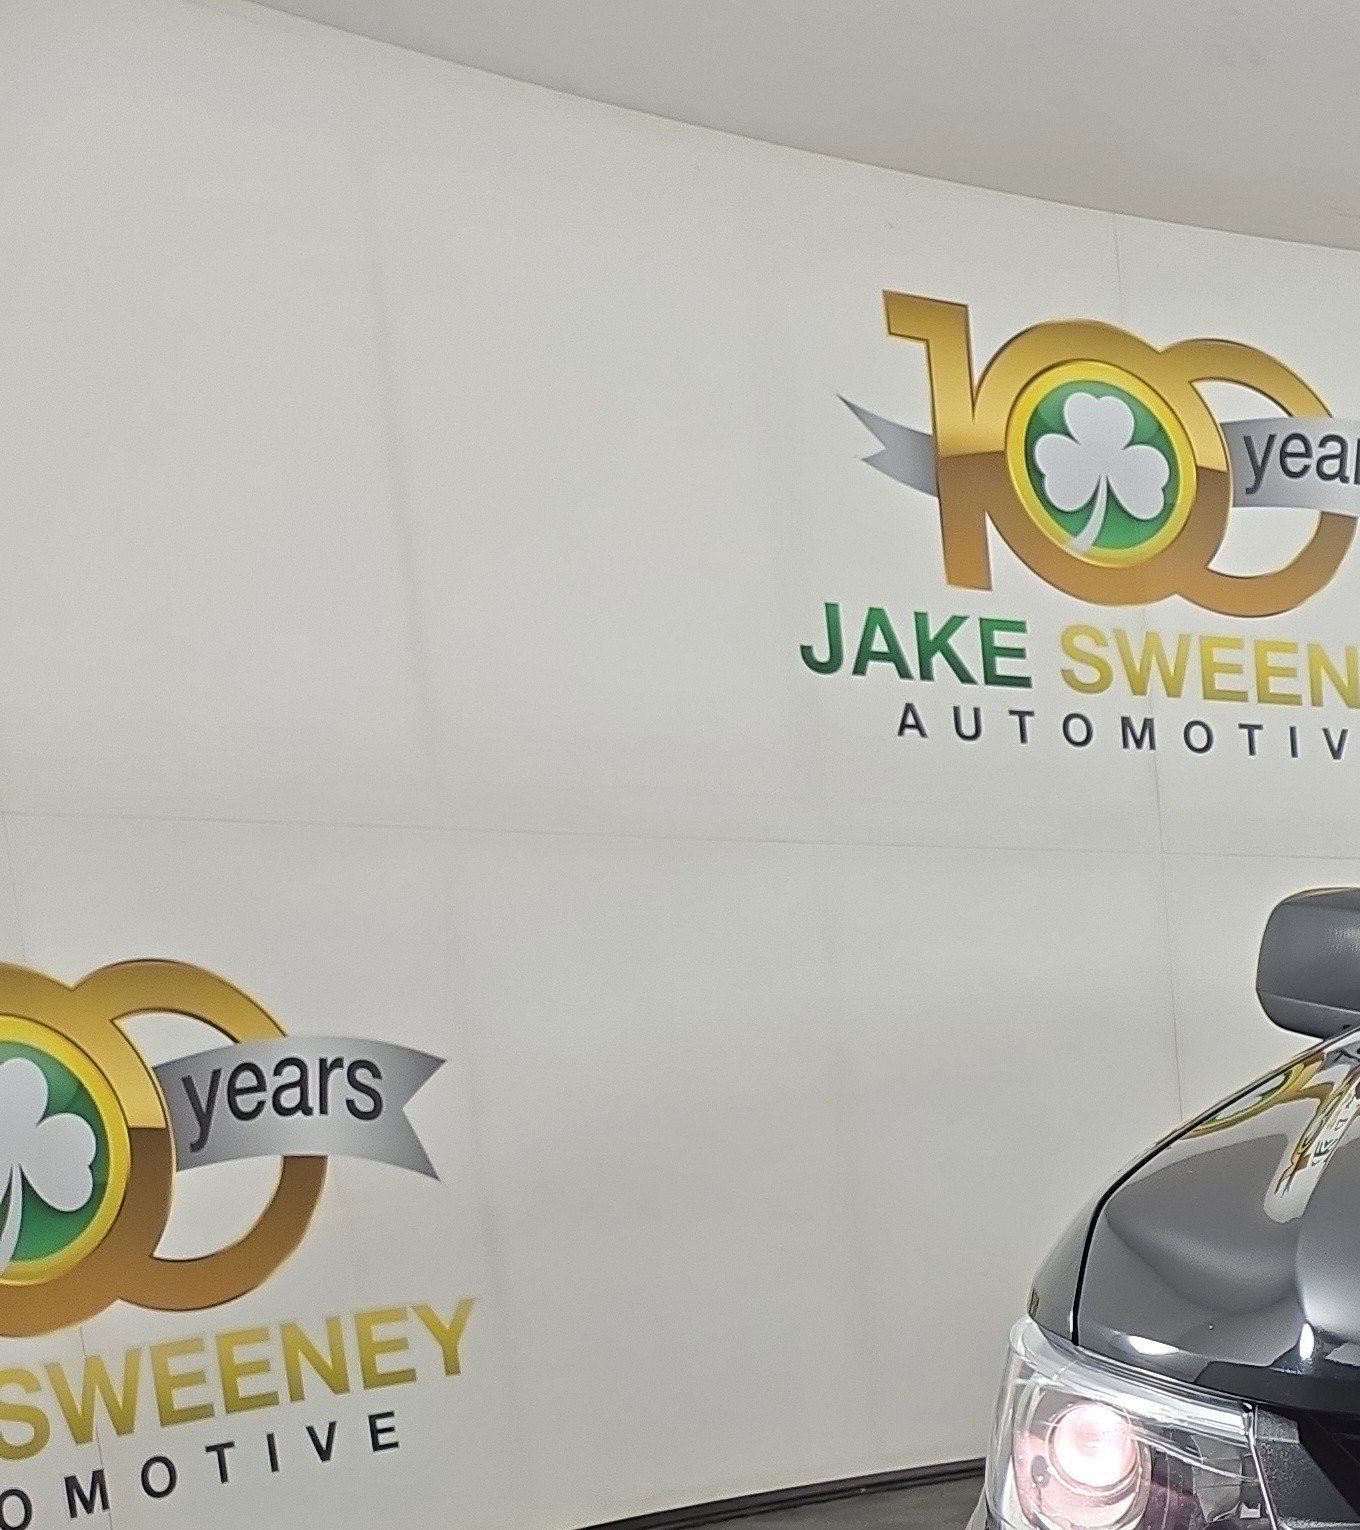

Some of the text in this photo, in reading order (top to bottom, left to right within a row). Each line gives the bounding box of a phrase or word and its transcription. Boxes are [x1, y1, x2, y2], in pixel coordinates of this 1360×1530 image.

[882, 289, 1359, 618] 100
[800, 602, 1033, 690] JAKE
[180, 1056, 384, 1152] years
